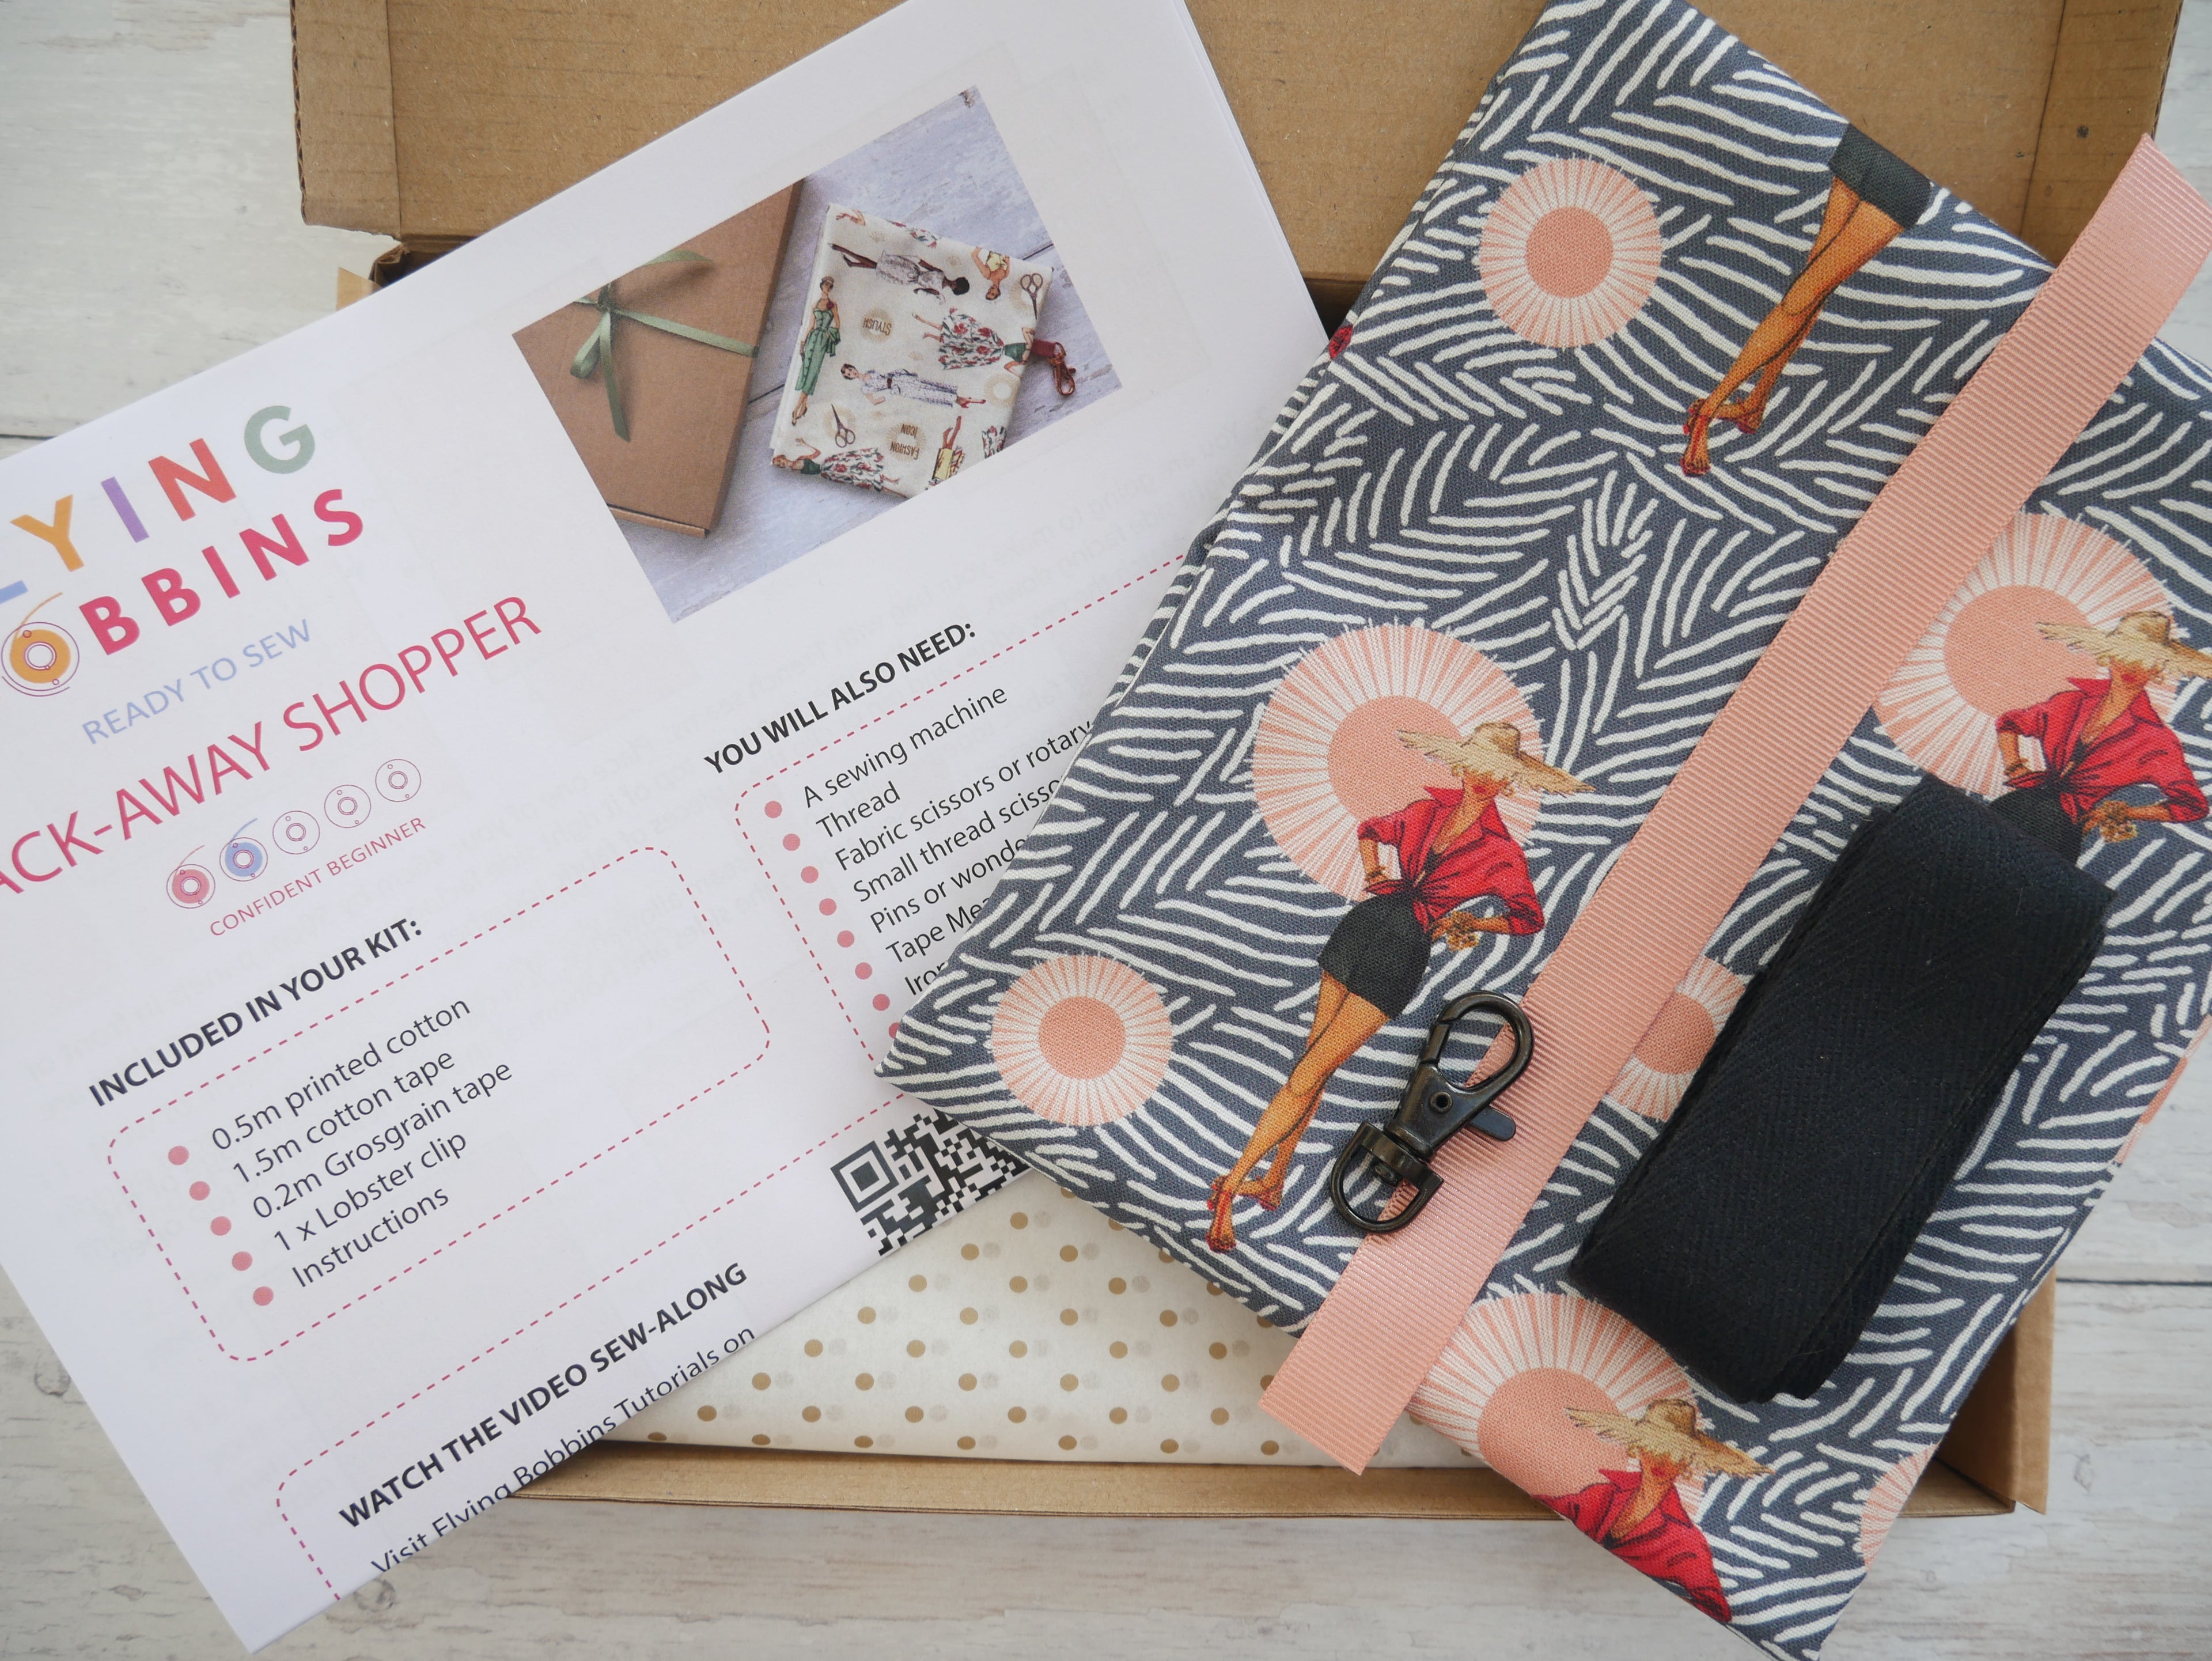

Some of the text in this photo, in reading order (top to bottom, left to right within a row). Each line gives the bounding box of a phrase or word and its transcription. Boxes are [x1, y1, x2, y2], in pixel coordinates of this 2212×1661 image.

[862, 317, 892, 336] STYLISH
[890, 441, 920, 460] FASHION
[900, 423, 918, 439] ICON
[0, 405, 316, 604] YING
[82, 619, 310, 744] READY TO SEW
[283, 596, 542, 752] SHOPPER
[703, 623, 976, 774] YOU WILL ALSO NEED:
[804, 688, 1007, 809] A sewing machine
[815, 780, 901, 838] Thread
[835, 823, 908, 871] Fabric
[910, 775, 995, 832] scissors
[998, 759, 1021, 782] or
[853, 852, 919, 902] Small
[919, 809, 996, 865] thread
[210, 868, 321, 936] CONFIDENT
[326, 818, 426, 876] BEGINNER
[870, 898, 921, 934] Pins
[923, 881, 947, 905] or
[885, 897, 990, 963] Tape Me
[88, 918, 422, 1107] INCLUDED IN YOUR KIT:
[211, 1000, 471, 1150] 0.5m printed cotton
[233, 1053, 455, 1183] 1.5m cotton tape
[253, 1064, 513, 1219] 0.2m Grosgrain tape
[274, 1134, 467, 1251] 1 x Lobster clip
[291, 1188, 449, 1288] Instructions
[338, 1262, 747, 1528] WATCH THE VIDEO SEW-ALONG
[370, 1533, 429, 1572] Visit
[513, 1416, 616, 1487] Bobbins
[613, 1348, 719, 1419] Tutorials
[724, 1328, 756, 1354] on
